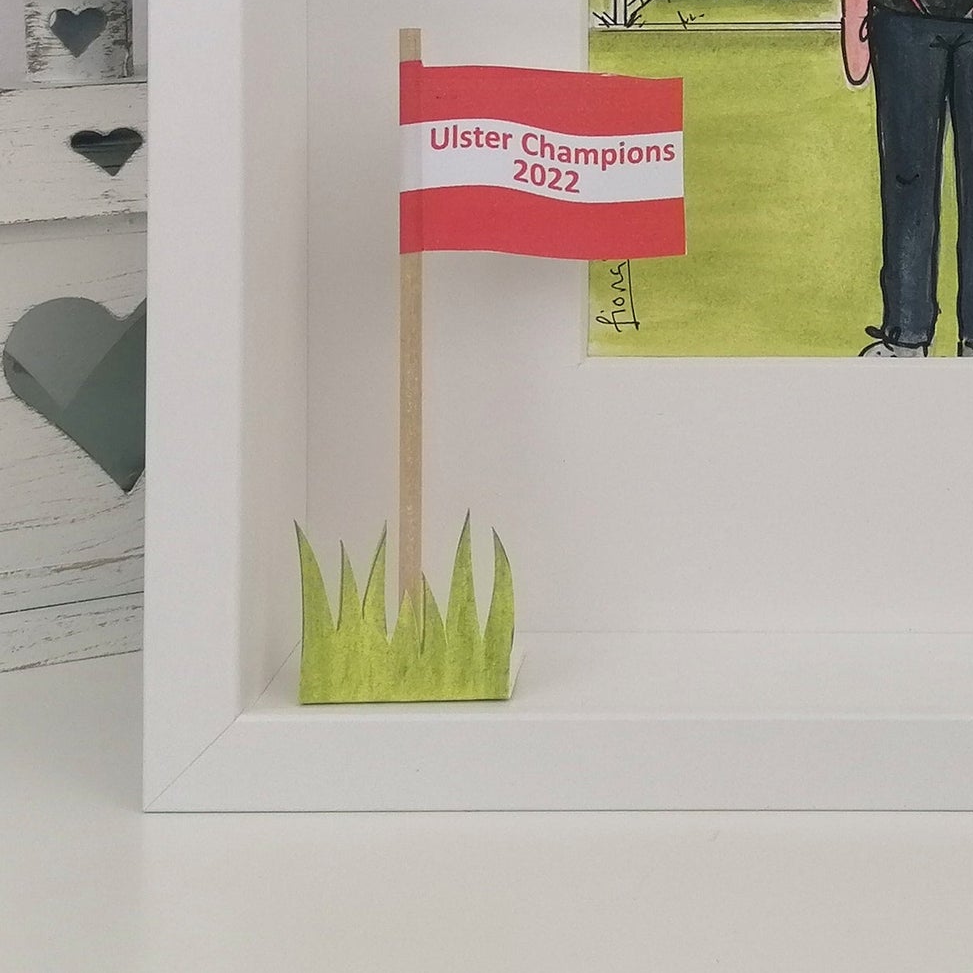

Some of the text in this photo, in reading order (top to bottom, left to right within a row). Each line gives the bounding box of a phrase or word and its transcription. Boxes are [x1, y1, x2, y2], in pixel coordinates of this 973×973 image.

[430, 125, 676, 171] Ulster Champions
[513, 159, 581, 194] 2022
